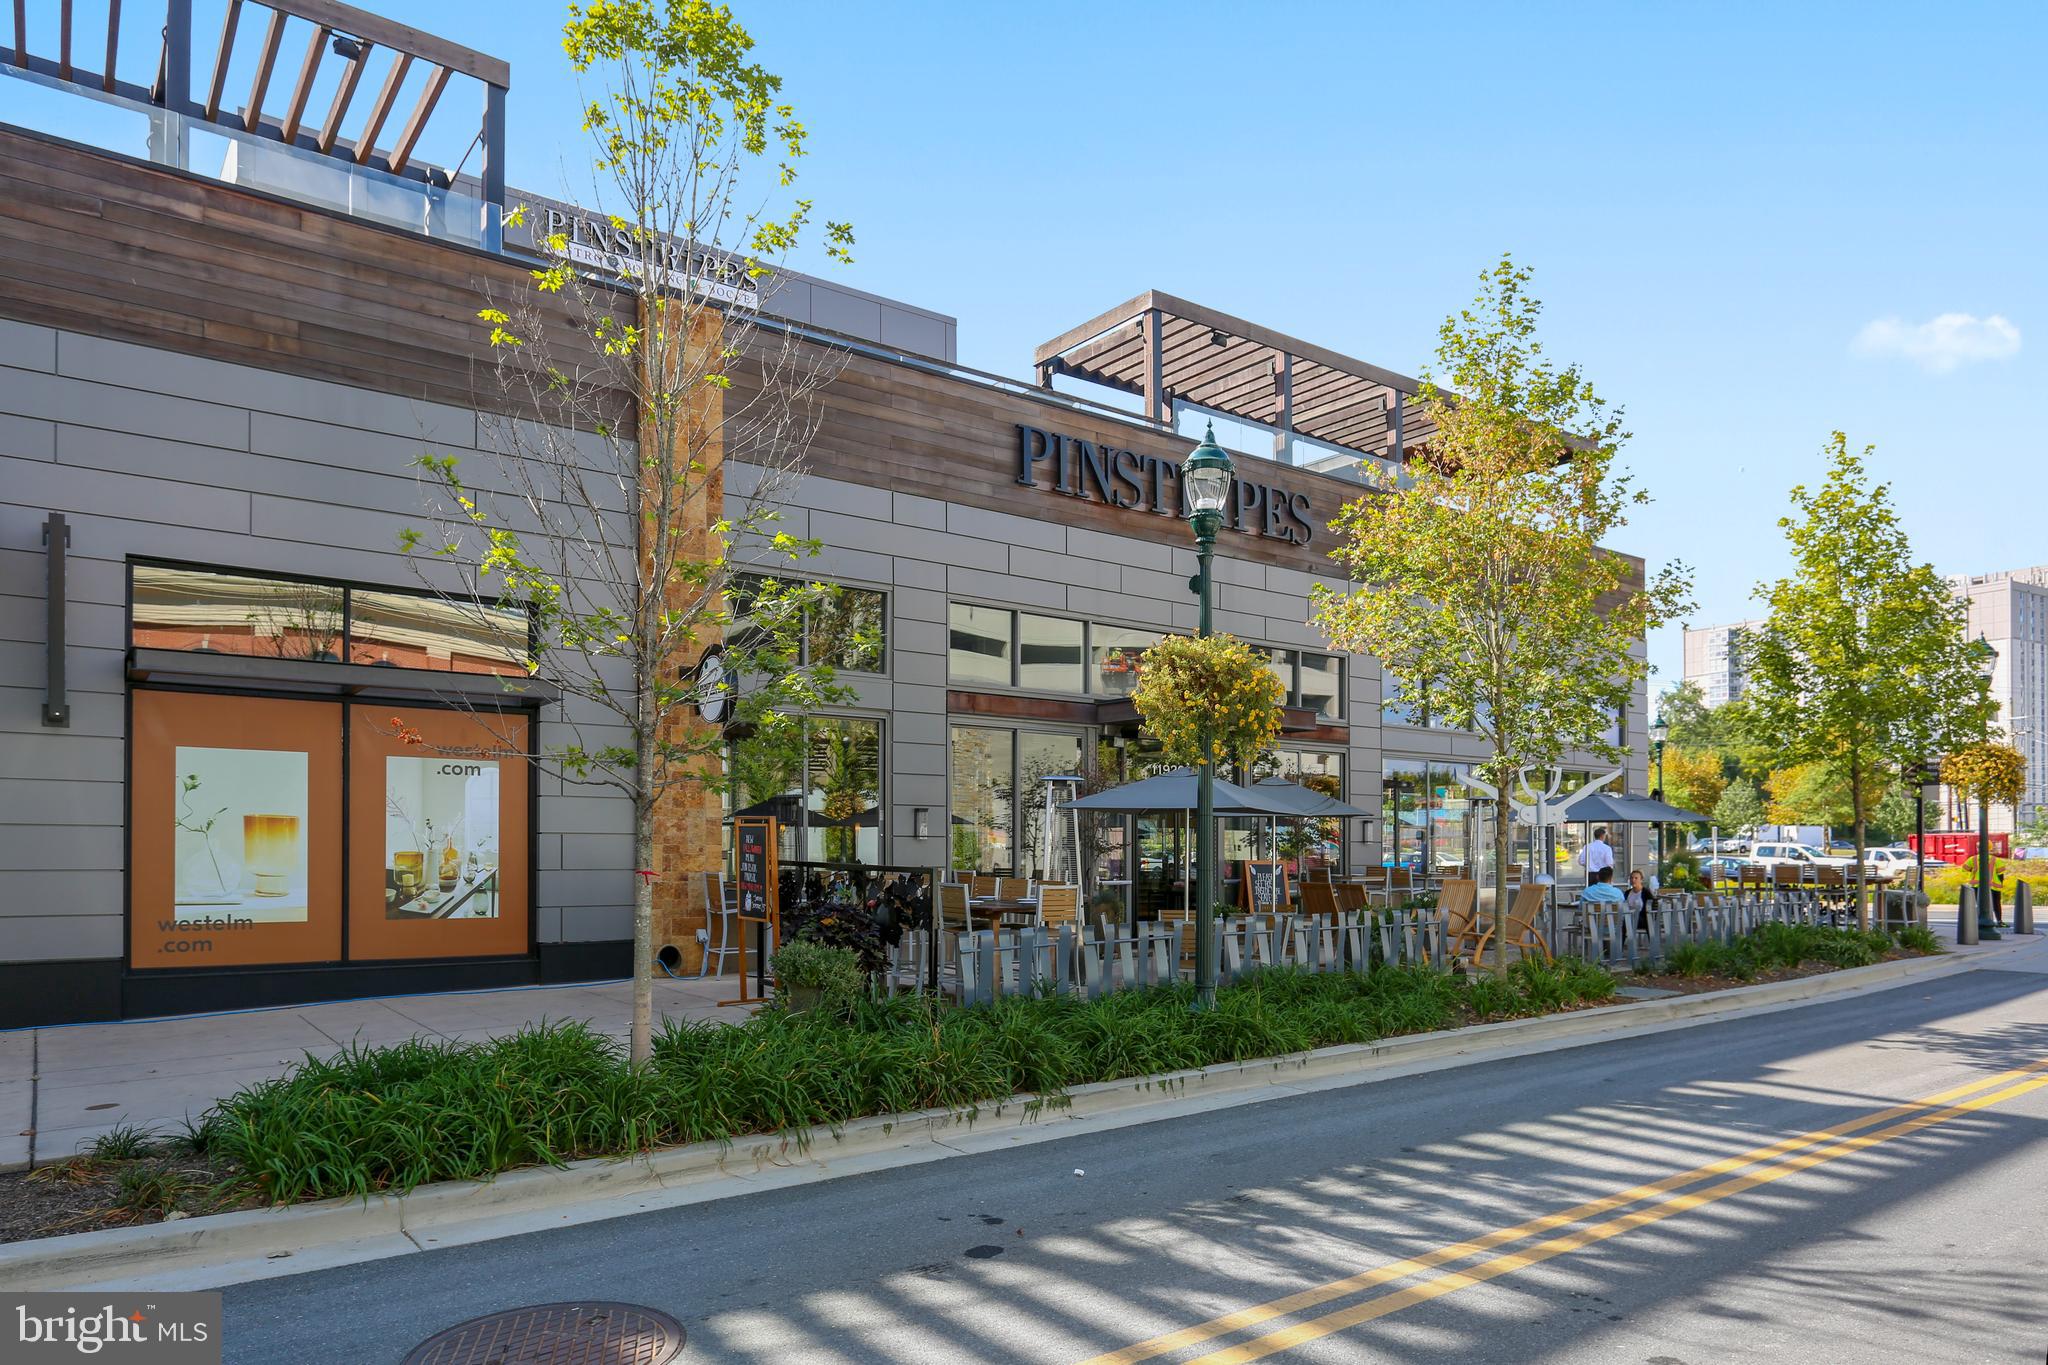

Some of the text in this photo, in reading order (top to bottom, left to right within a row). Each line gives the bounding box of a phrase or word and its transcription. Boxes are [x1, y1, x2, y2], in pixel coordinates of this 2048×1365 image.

[437, 763, 481, 776] .com
[157, 913, 254, 933] westelm
[157, 936, 213, 953] .com
